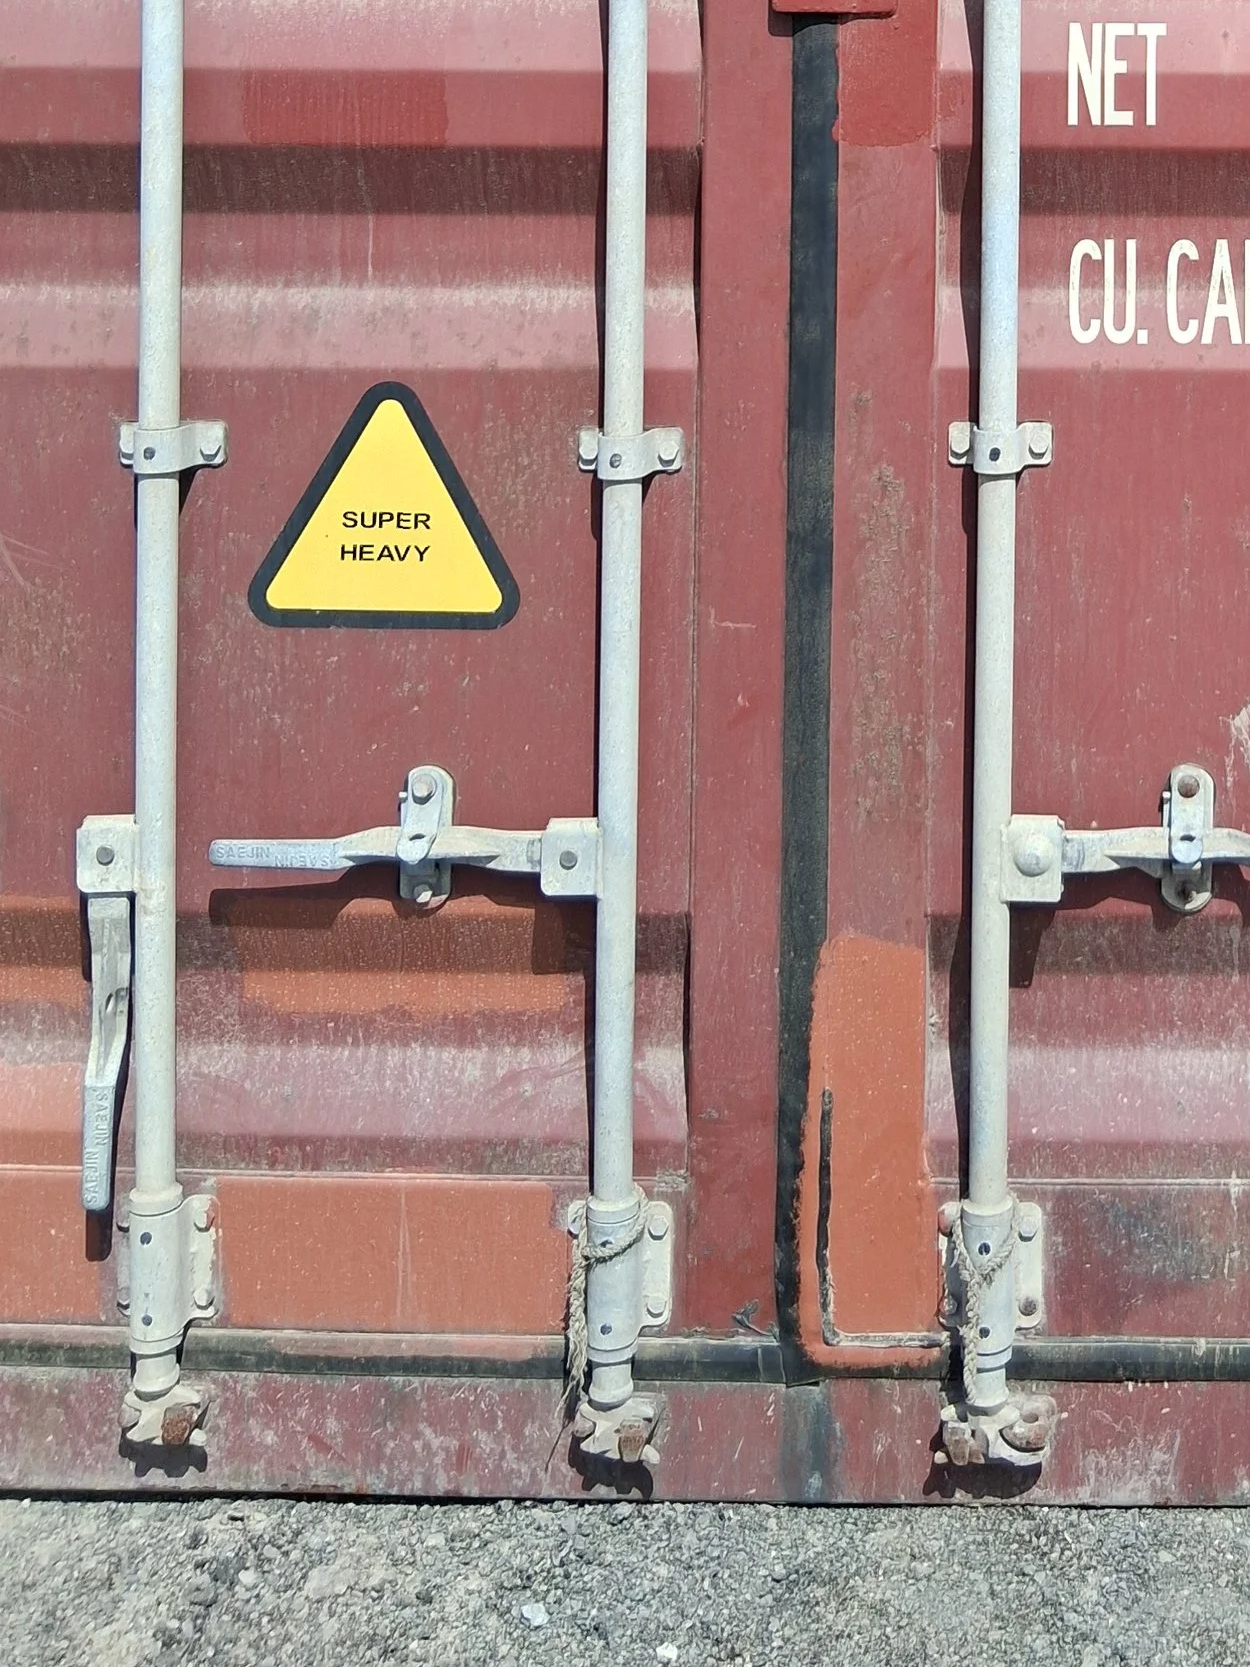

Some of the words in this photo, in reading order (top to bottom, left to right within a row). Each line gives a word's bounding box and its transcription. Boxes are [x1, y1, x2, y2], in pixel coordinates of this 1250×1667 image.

[1067, 23, 1168, 127] NET
[1068, 238, 1149, 346] CU.
[342, 511, 431, 530] SUPER
[340, 544, 430, 562] HEAVY
[215, 844, 270, 859] SAEJIN
[84, 1149, 100, 1205] SAEJIN
